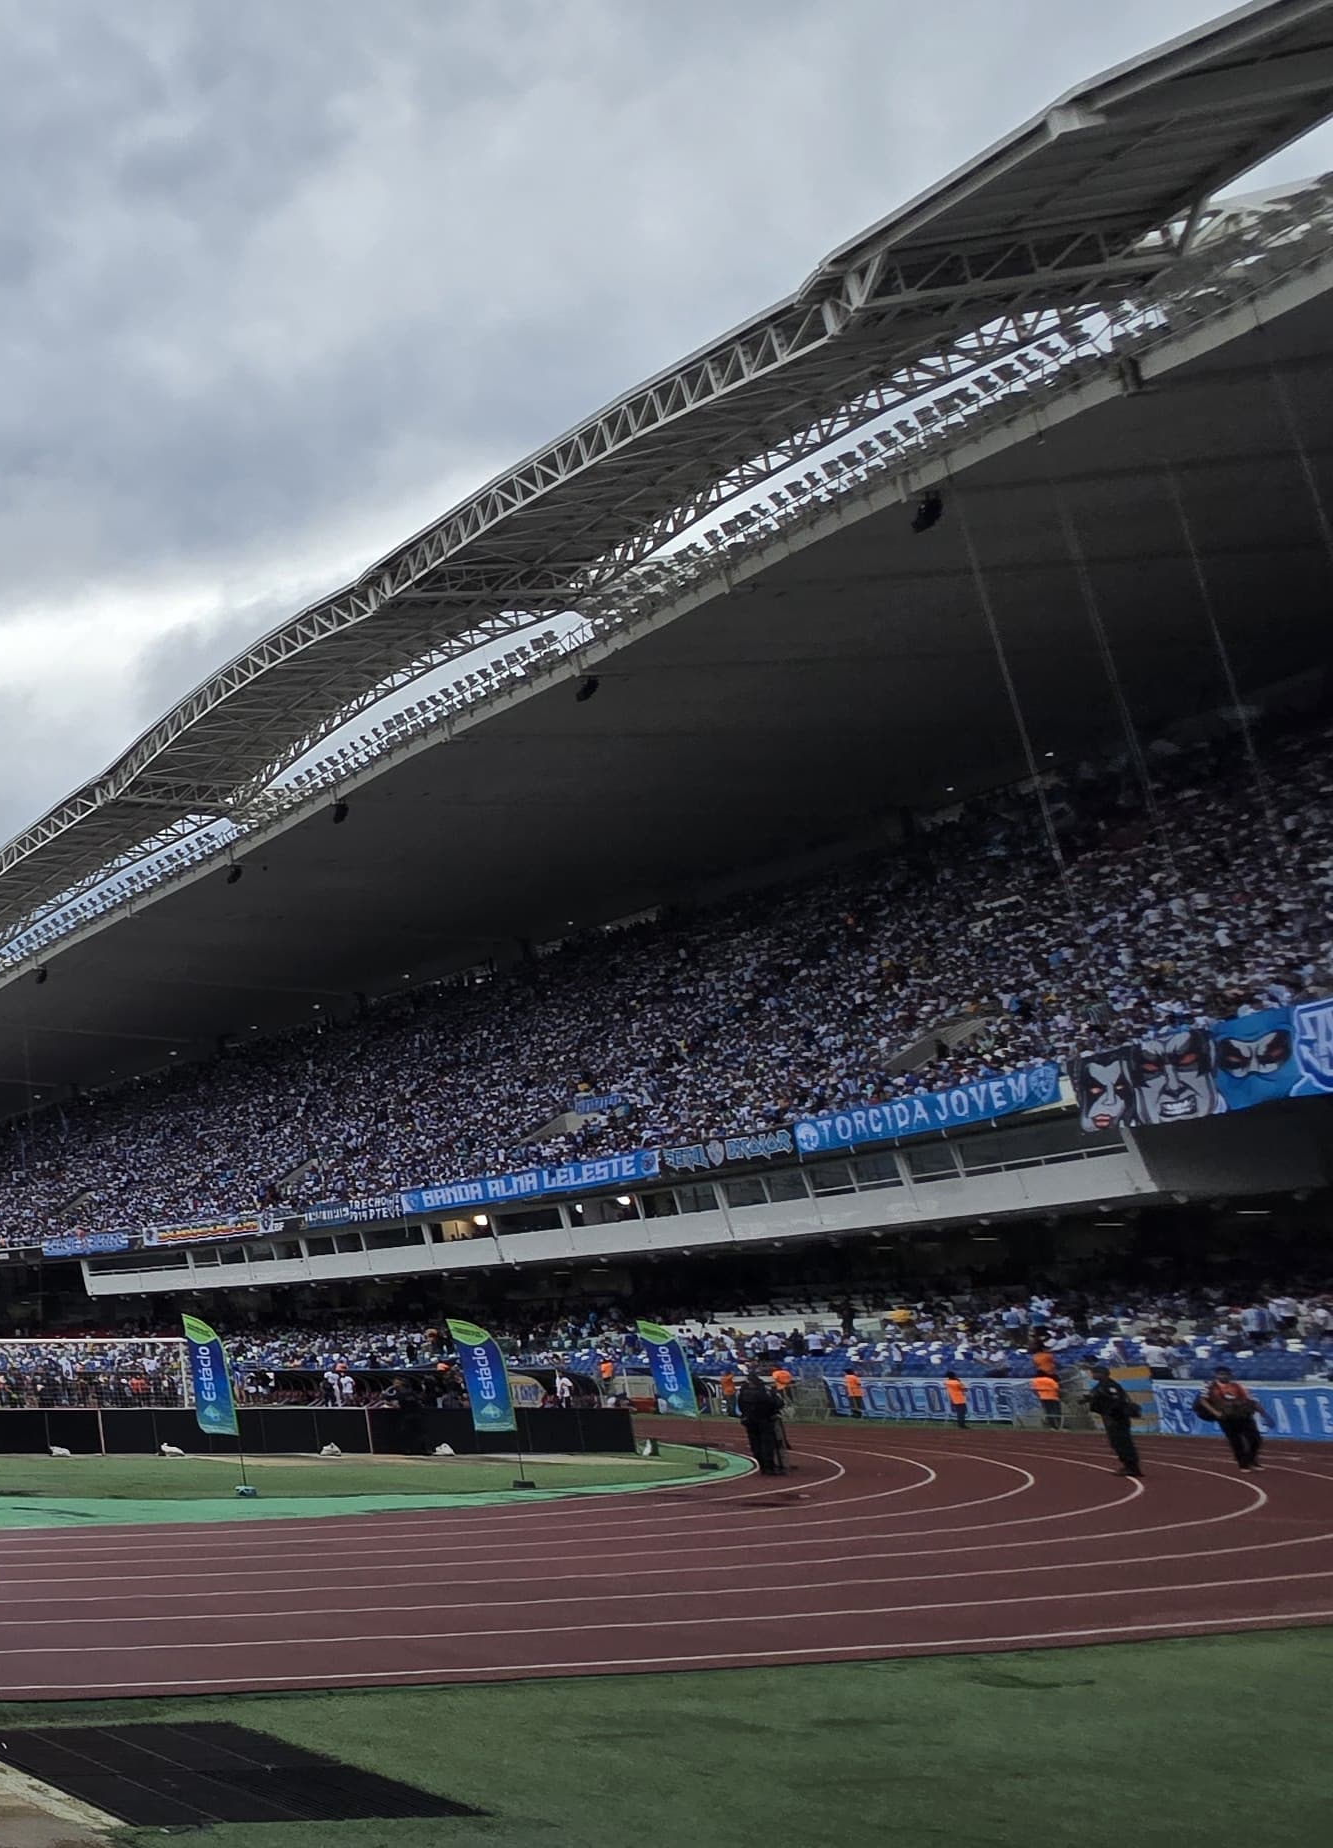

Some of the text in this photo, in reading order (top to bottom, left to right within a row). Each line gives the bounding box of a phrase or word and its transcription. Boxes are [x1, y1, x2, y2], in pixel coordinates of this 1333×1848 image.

[817, 1073, 1028, 1141] TORCIDA JOVEM
[421, 1183, 484, 1208] BANDA
[488, 1172, 538, 1198] ALMA
[196, 1345, 217, 1402] Estácio
[472, 1346, 497, 1400] Estácio
[656, 1346, 679, 1392] Estácio
[834, 1377, 1014, 1418] BCOLOOS
